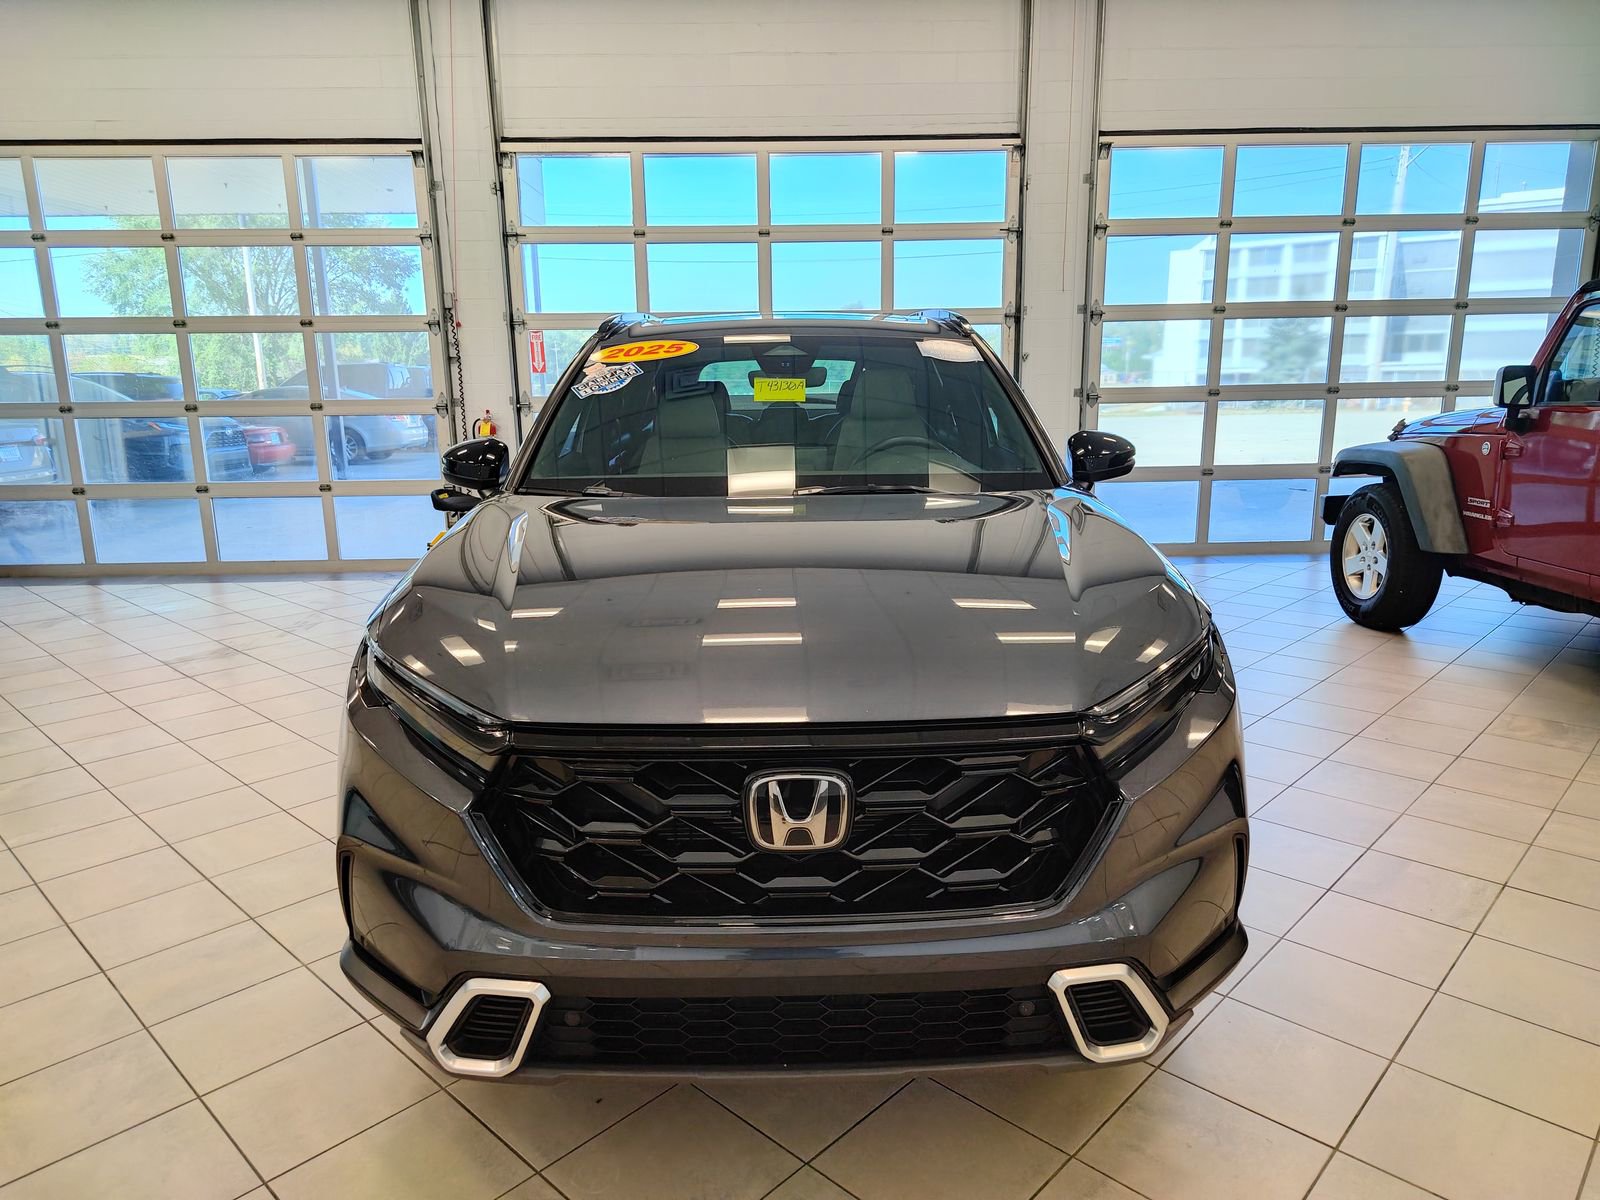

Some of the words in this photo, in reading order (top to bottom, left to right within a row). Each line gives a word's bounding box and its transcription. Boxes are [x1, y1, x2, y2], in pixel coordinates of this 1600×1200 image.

[601, 343, 687, 360] 2025
[1468, 498, 1490, 507] SPORT
[1462, 510, 1493, 520] WRANGLER
